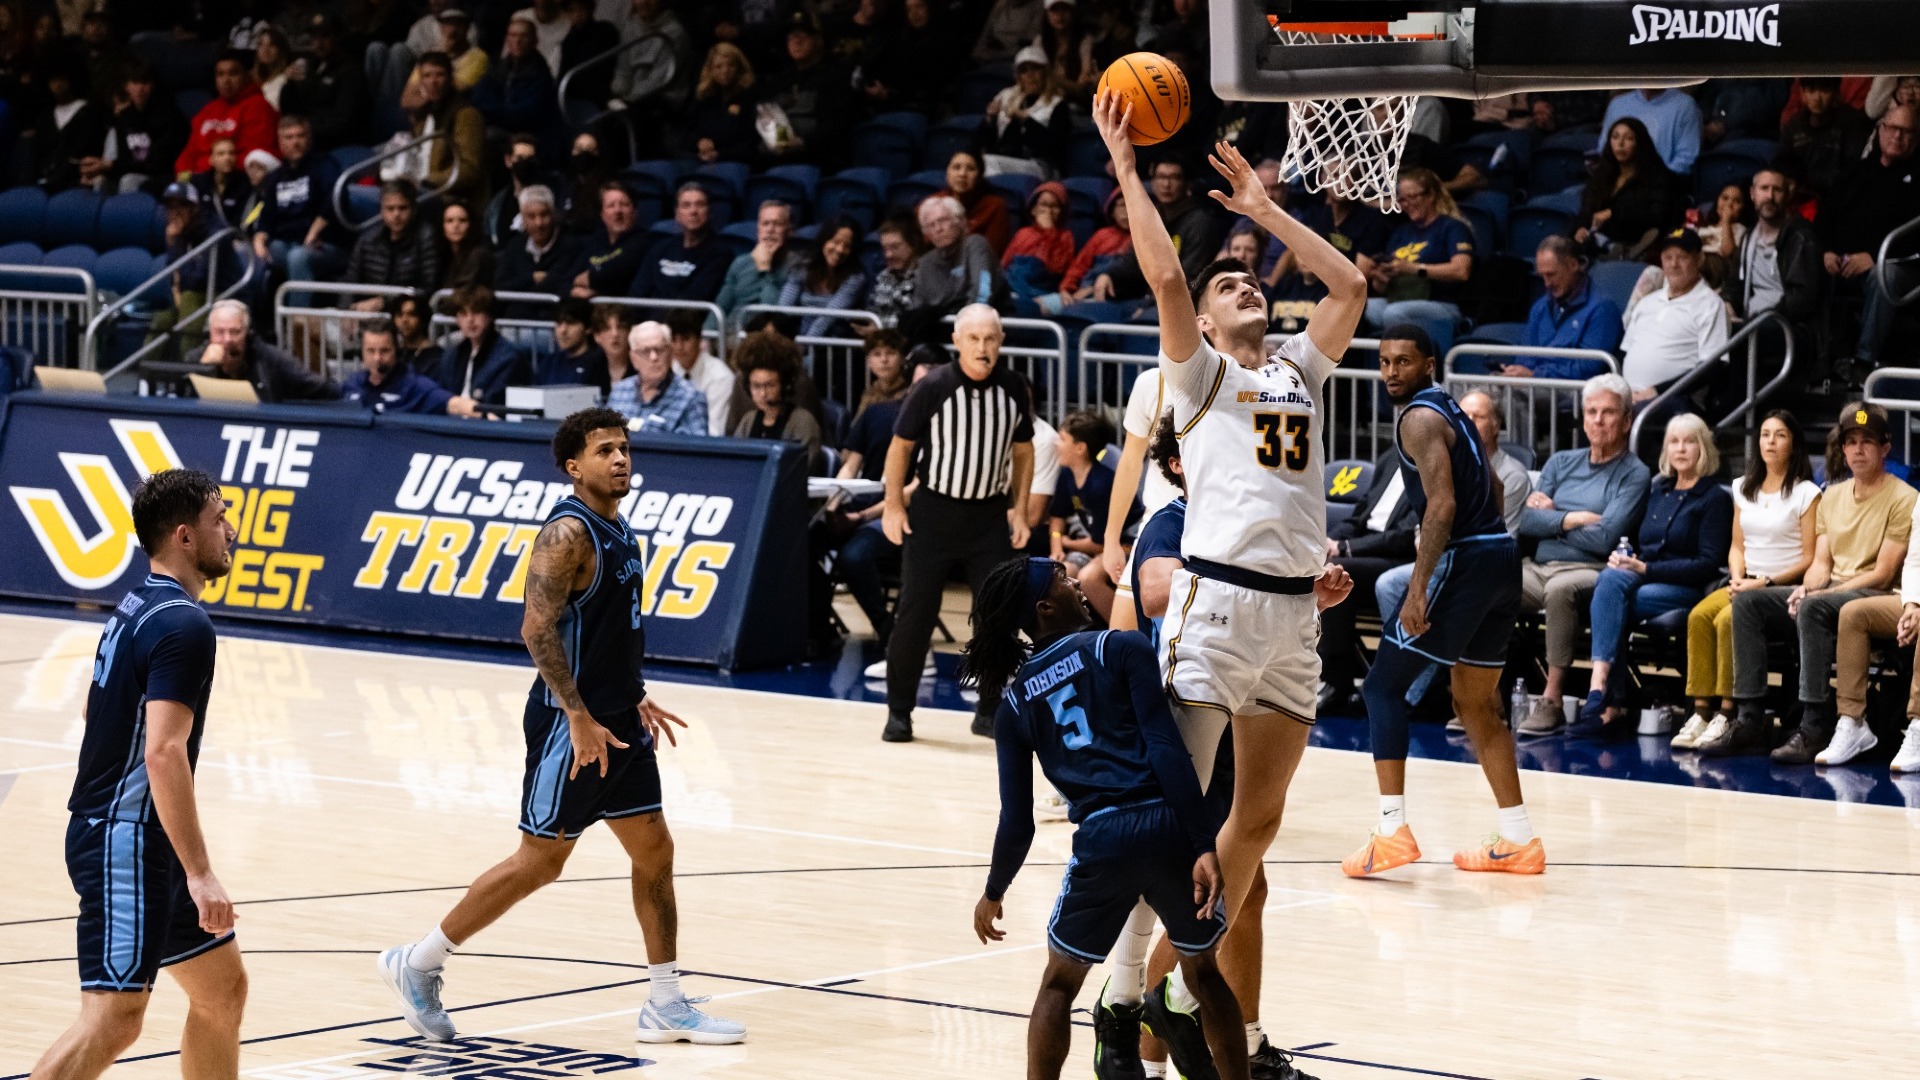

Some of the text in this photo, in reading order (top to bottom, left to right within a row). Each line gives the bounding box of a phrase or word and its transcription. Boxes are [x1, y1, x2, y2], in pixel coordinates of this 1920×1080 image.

[1630, 4, 1780, 46] SPALDING
[1145, 66, 1171, 97] EVO
[1236, 391, 1312, 408] UCSanDio
[221, 425, 320, 488] THE
[1252, 411, 1310, 472] 33
[394, 453, 733, 546] UCSaniego
[353, 511, 735, 619] TRITNS
[1023, 650, 1085, 701] JOHNSON
[1045, 682, 1094, 751] 5
